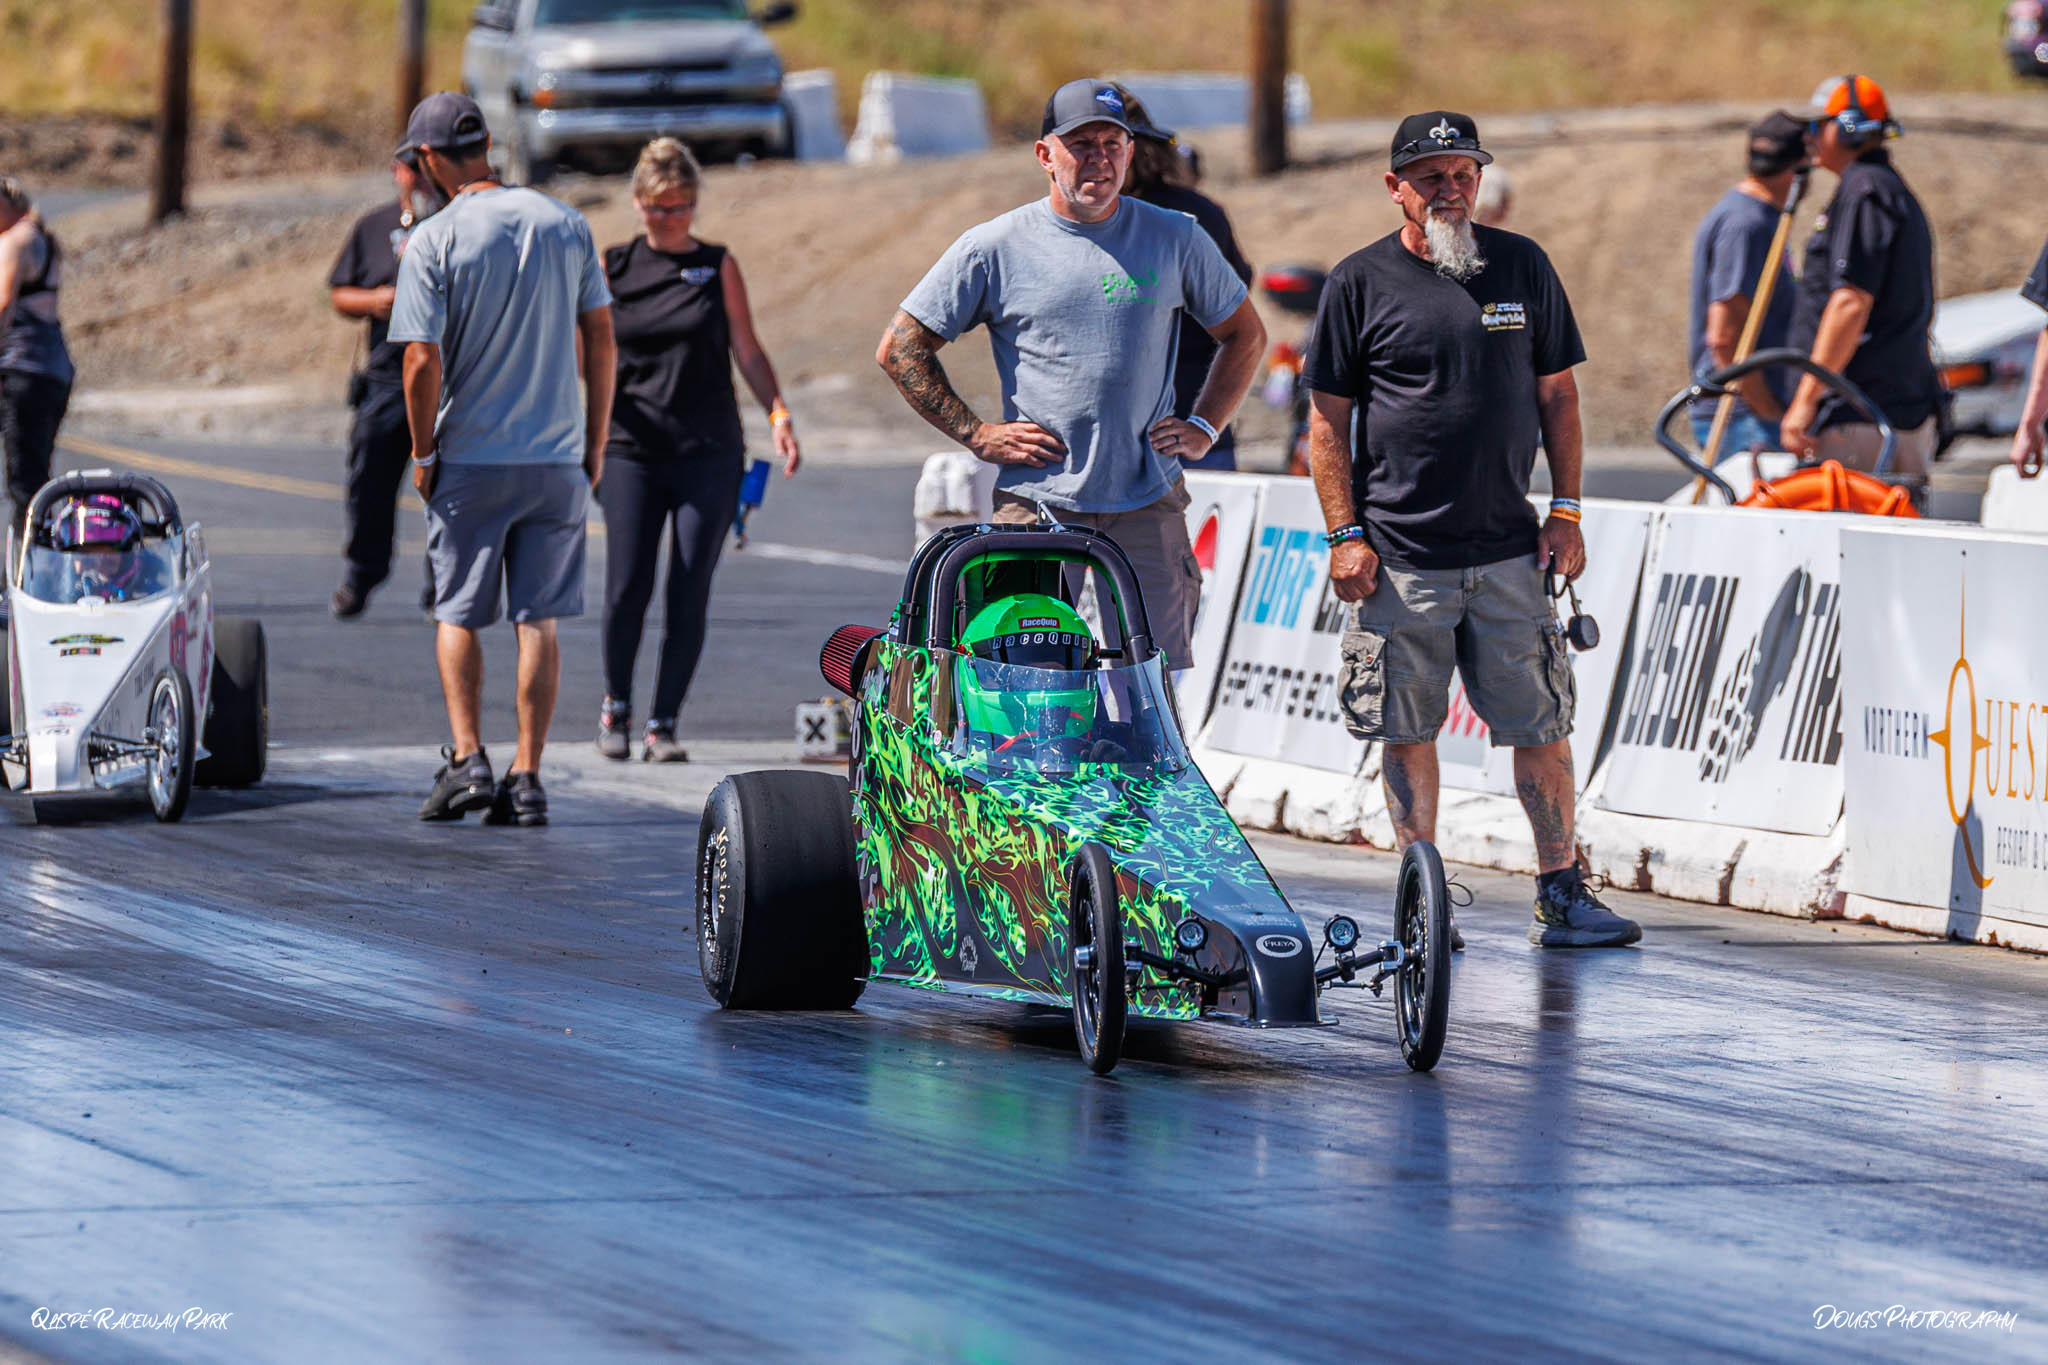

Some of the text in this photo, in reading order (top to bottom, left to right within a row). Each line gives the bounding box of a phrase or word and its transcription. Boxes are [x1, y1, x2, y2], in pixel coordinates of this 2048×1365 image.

[1242, 526, 1329, 630] TURF
[1021, 618, 1059, 628] RaceQuip
[1620, 573, 1740, 752] BISON
[1864, 706, 1929, 760] NORTHERN
[1264, 940, 1296, 948] FREYA
